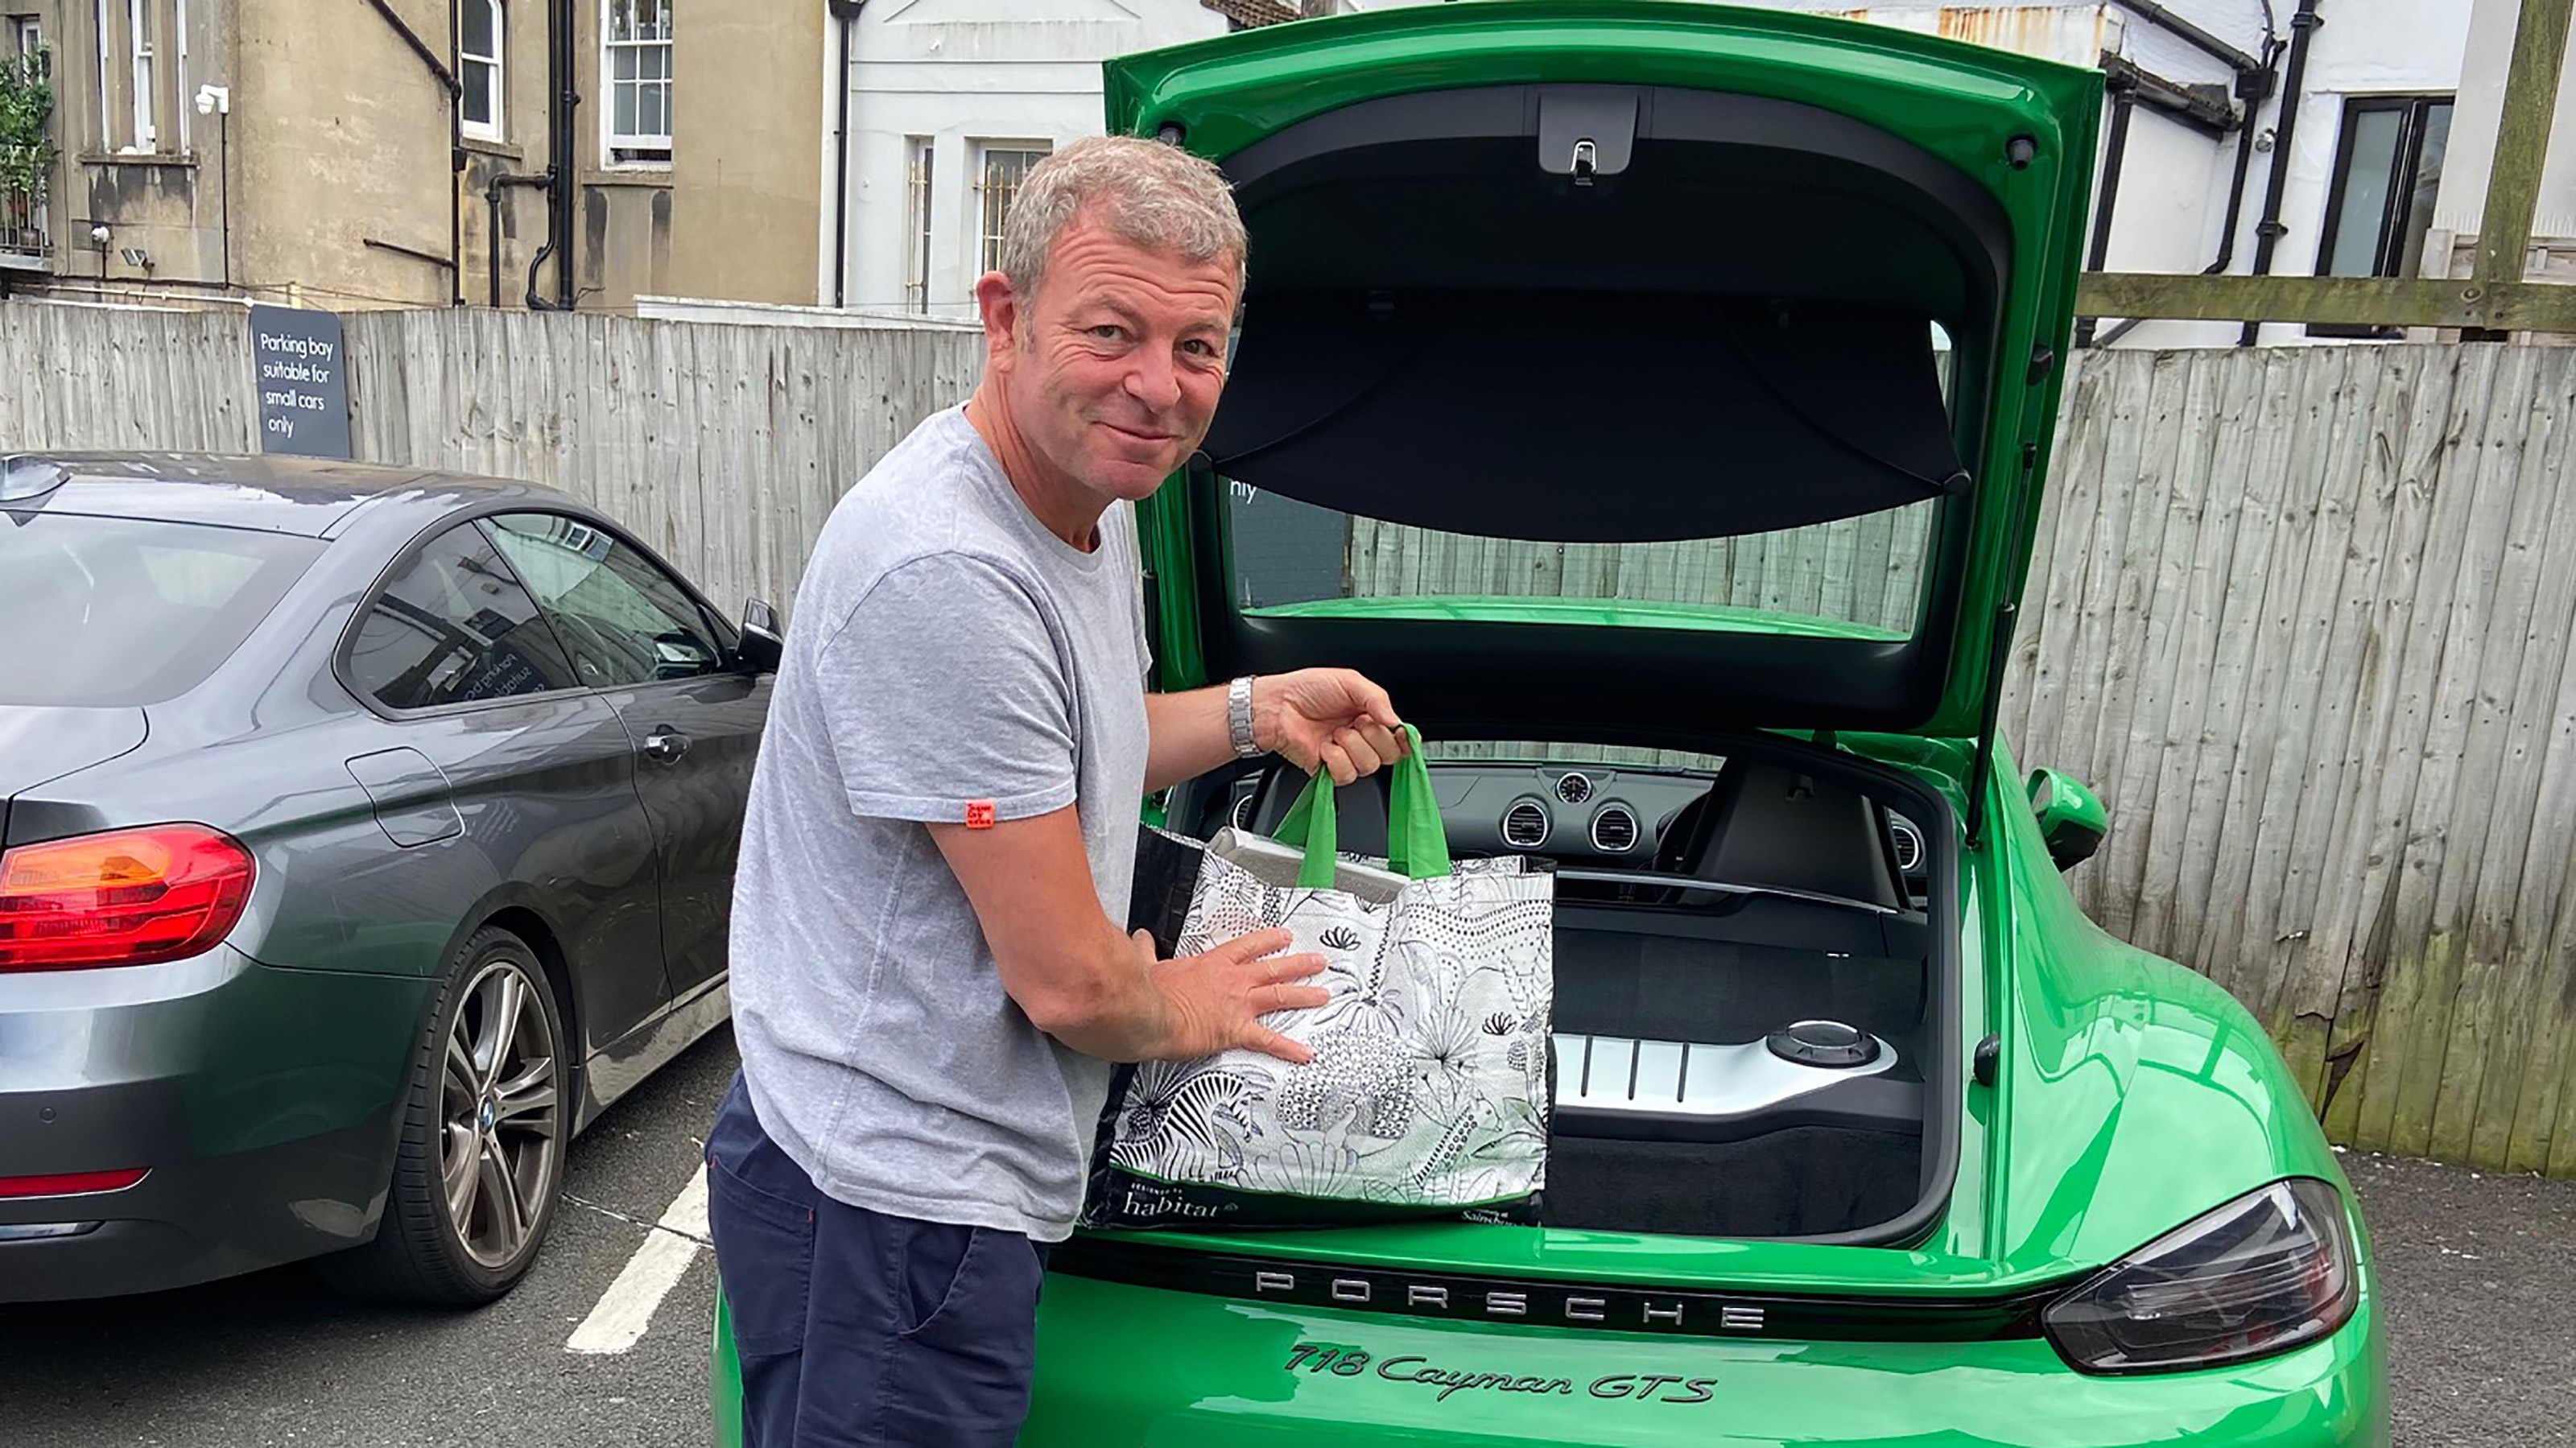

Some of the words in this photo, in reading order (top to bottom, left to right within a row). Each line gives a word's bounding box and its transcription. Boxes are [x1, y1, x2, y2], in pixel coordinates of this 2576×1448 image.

[260, 332, 307, 359] Parking
[308, 336, 333, 361] bay
[263, 361, 309, 382] suitable
[312, 364, 330, 383] for
[266, 389, 296, 407] small
[298, 395, 325, 410] cars
[268, 415, 294, 438] only
[1230, 481, 1257, 504] nly
[1122, 1191, 1218, 1217] habitat
[1256, 1271, 1765, 1329] PORSCHE
[1283, 1344, 1370, 1376] 718
[1376, 1355, 1573, 1402] Cayman
[1588, 1373, 1719, 1404] GTS
